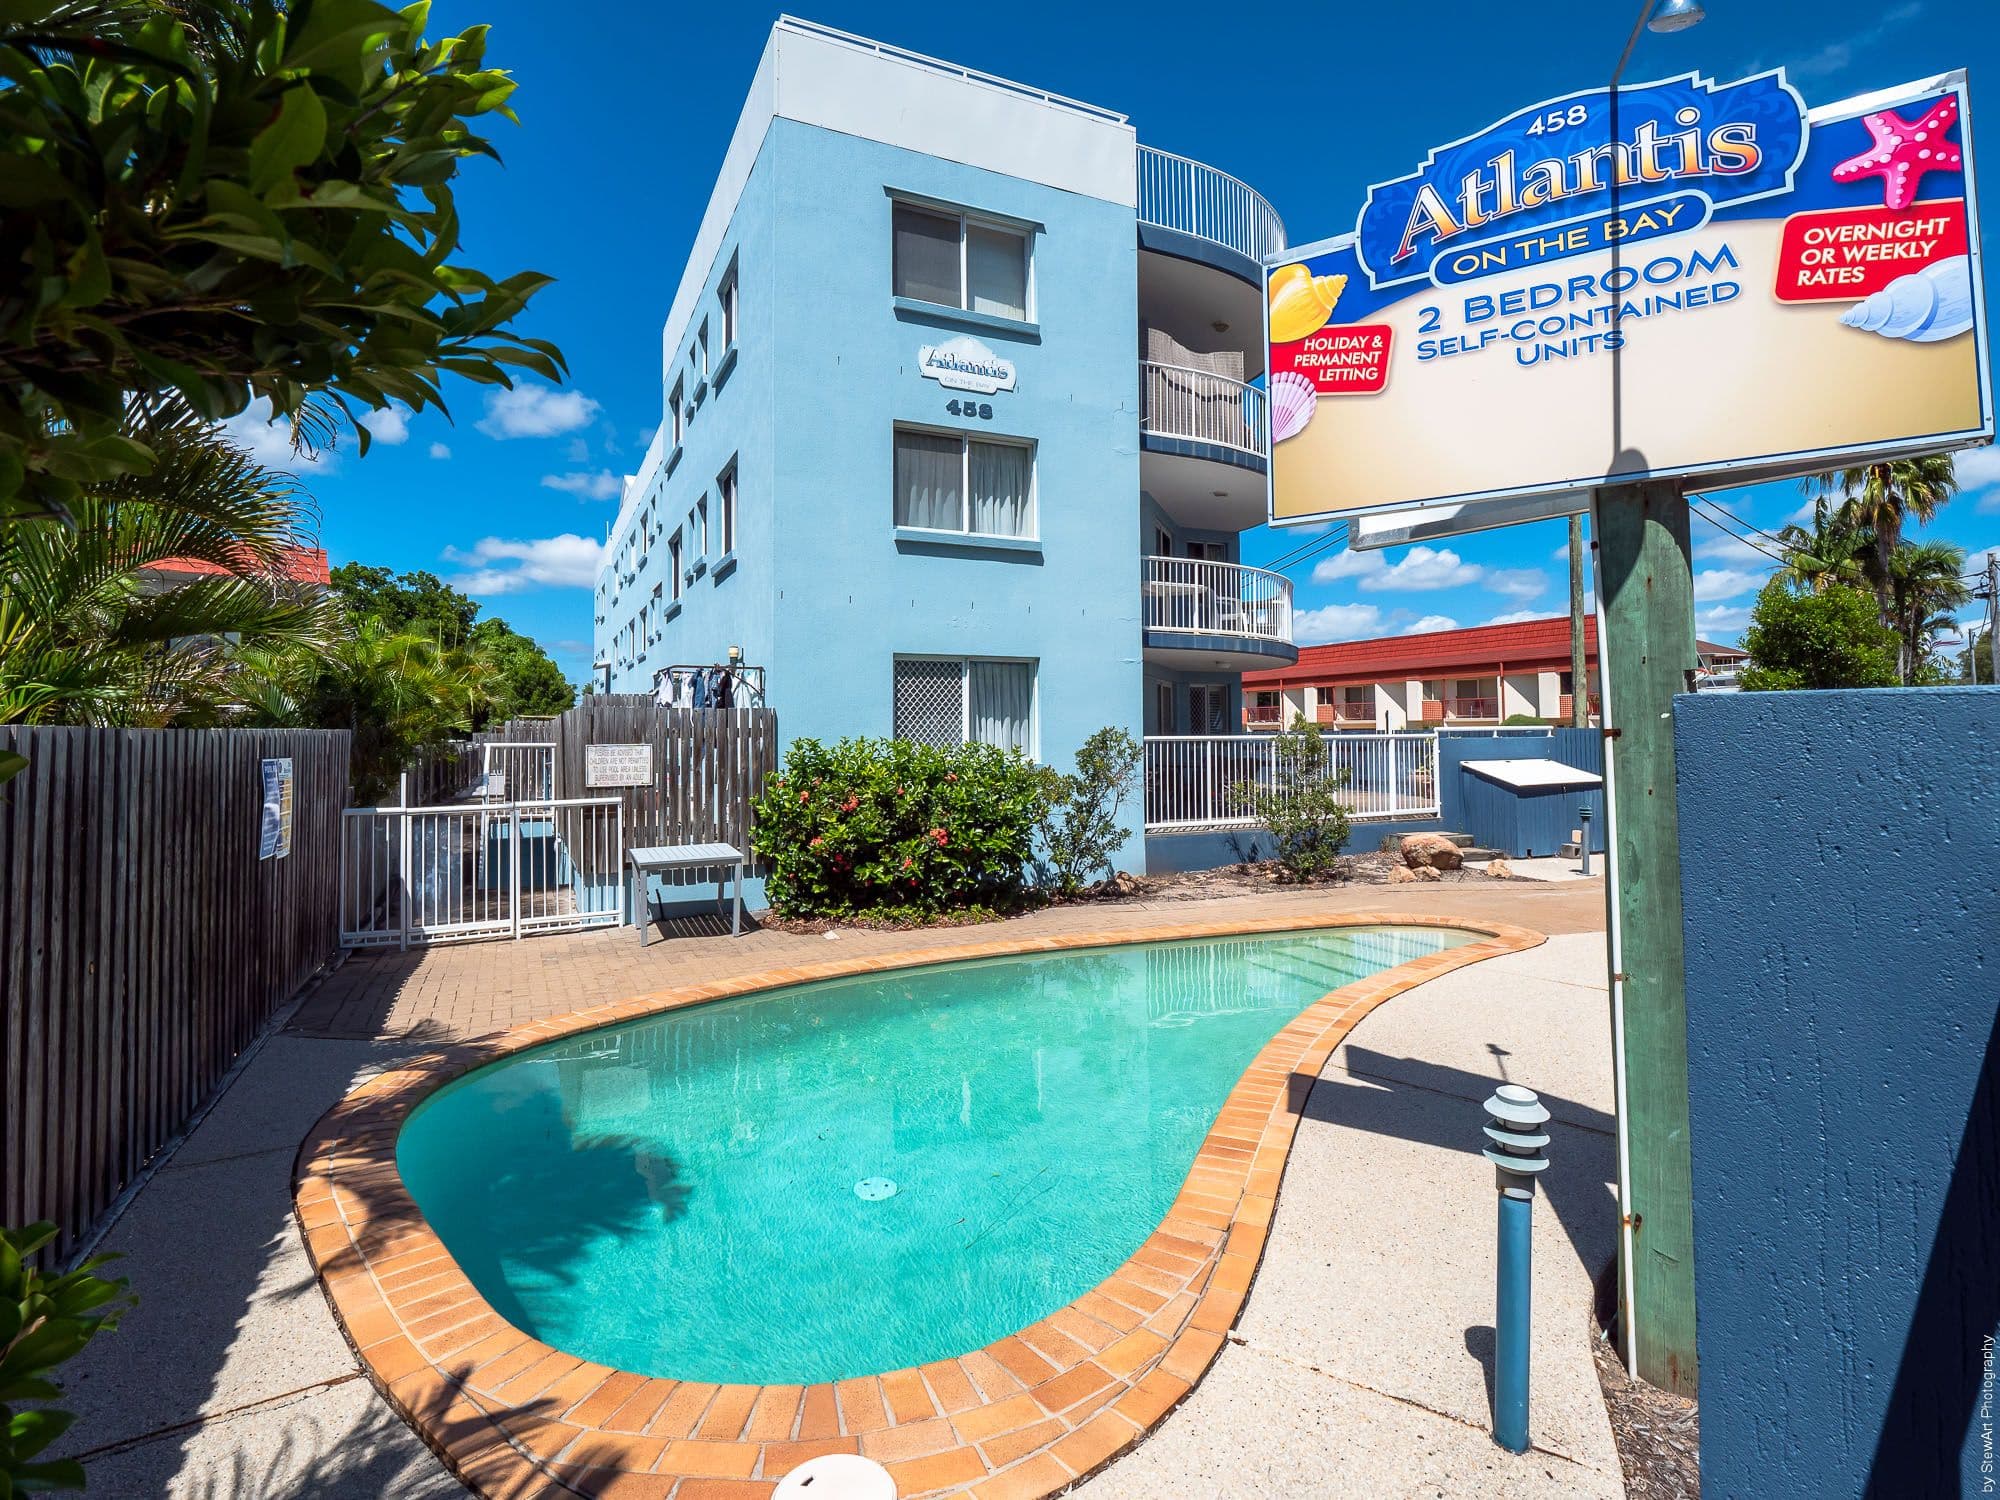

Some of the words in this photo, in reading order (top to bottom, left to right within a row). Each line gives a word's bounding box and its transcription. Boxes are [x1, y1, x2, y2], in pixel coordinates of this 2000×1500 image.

[1525, 104, 1588, 136] 458
[1390, 106, 1763, 266] Atlantis
[1452, 246, 1507, 275] ON
[1514, 226, 1590, 260] THE
[1603, 203, 1685, 242] BAY
[1803, 216, 1951, 245] OVERNIGHT
[1800, 247, 1836, 266] OR
[1841, 239, 1938, 264] WEEKLY
[1416, 306, 1442, 335] 2
[1463, 242, 1740, 325] BEDROOM
[1796, 266, 1866, 287] RATES
[1416, 281, 1742, 362] SELF-CONTAINED
[1303, 335, 1370, 352] HOLIDAY
[1371, 335, 1383, 349] &
[1515, 329, 1627, 367] UNITS
[926, 348, 1009, 379] Atlantis
[1293, 350, 1382, 368] PERMANENT
[1318, 367, 1379, 382] LETTING
[945, 398, 993, 420] 458
